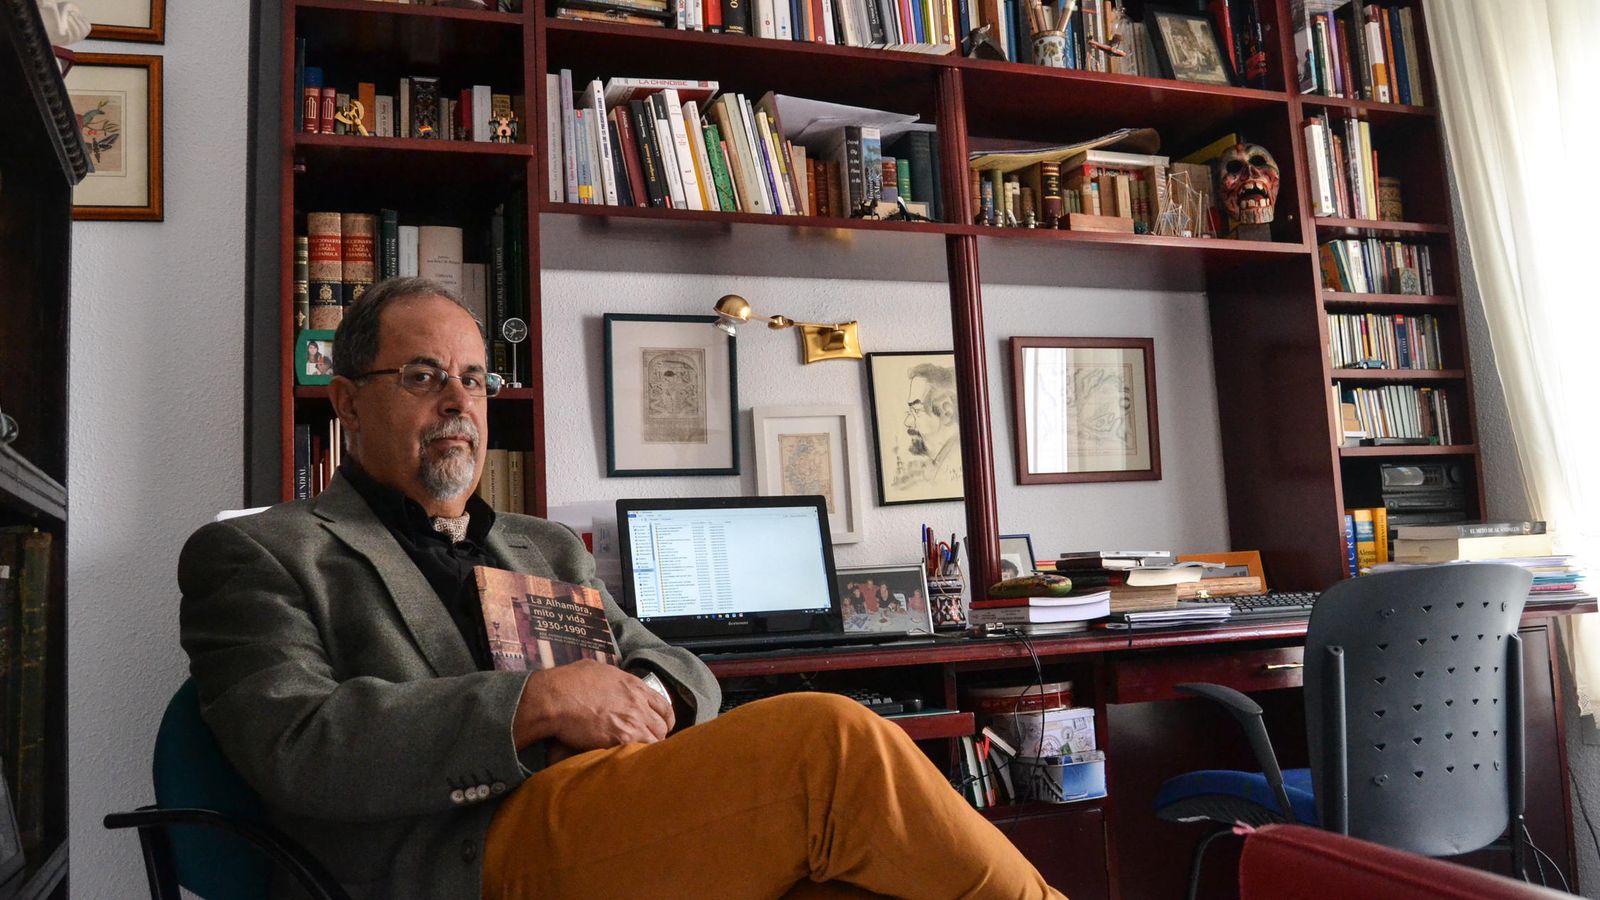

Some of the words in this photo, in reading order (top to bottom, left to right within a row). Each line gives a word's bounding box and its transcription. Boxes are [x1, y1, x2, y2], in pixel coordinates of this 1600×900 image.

[531, 597, 542, 605] La
[545, 598, 592, 616] Alhambra,
[533, 608, 555, 618] mito
[567, 614, 586, 624] vida
[537, 620, 586, 636] 1930-1990
